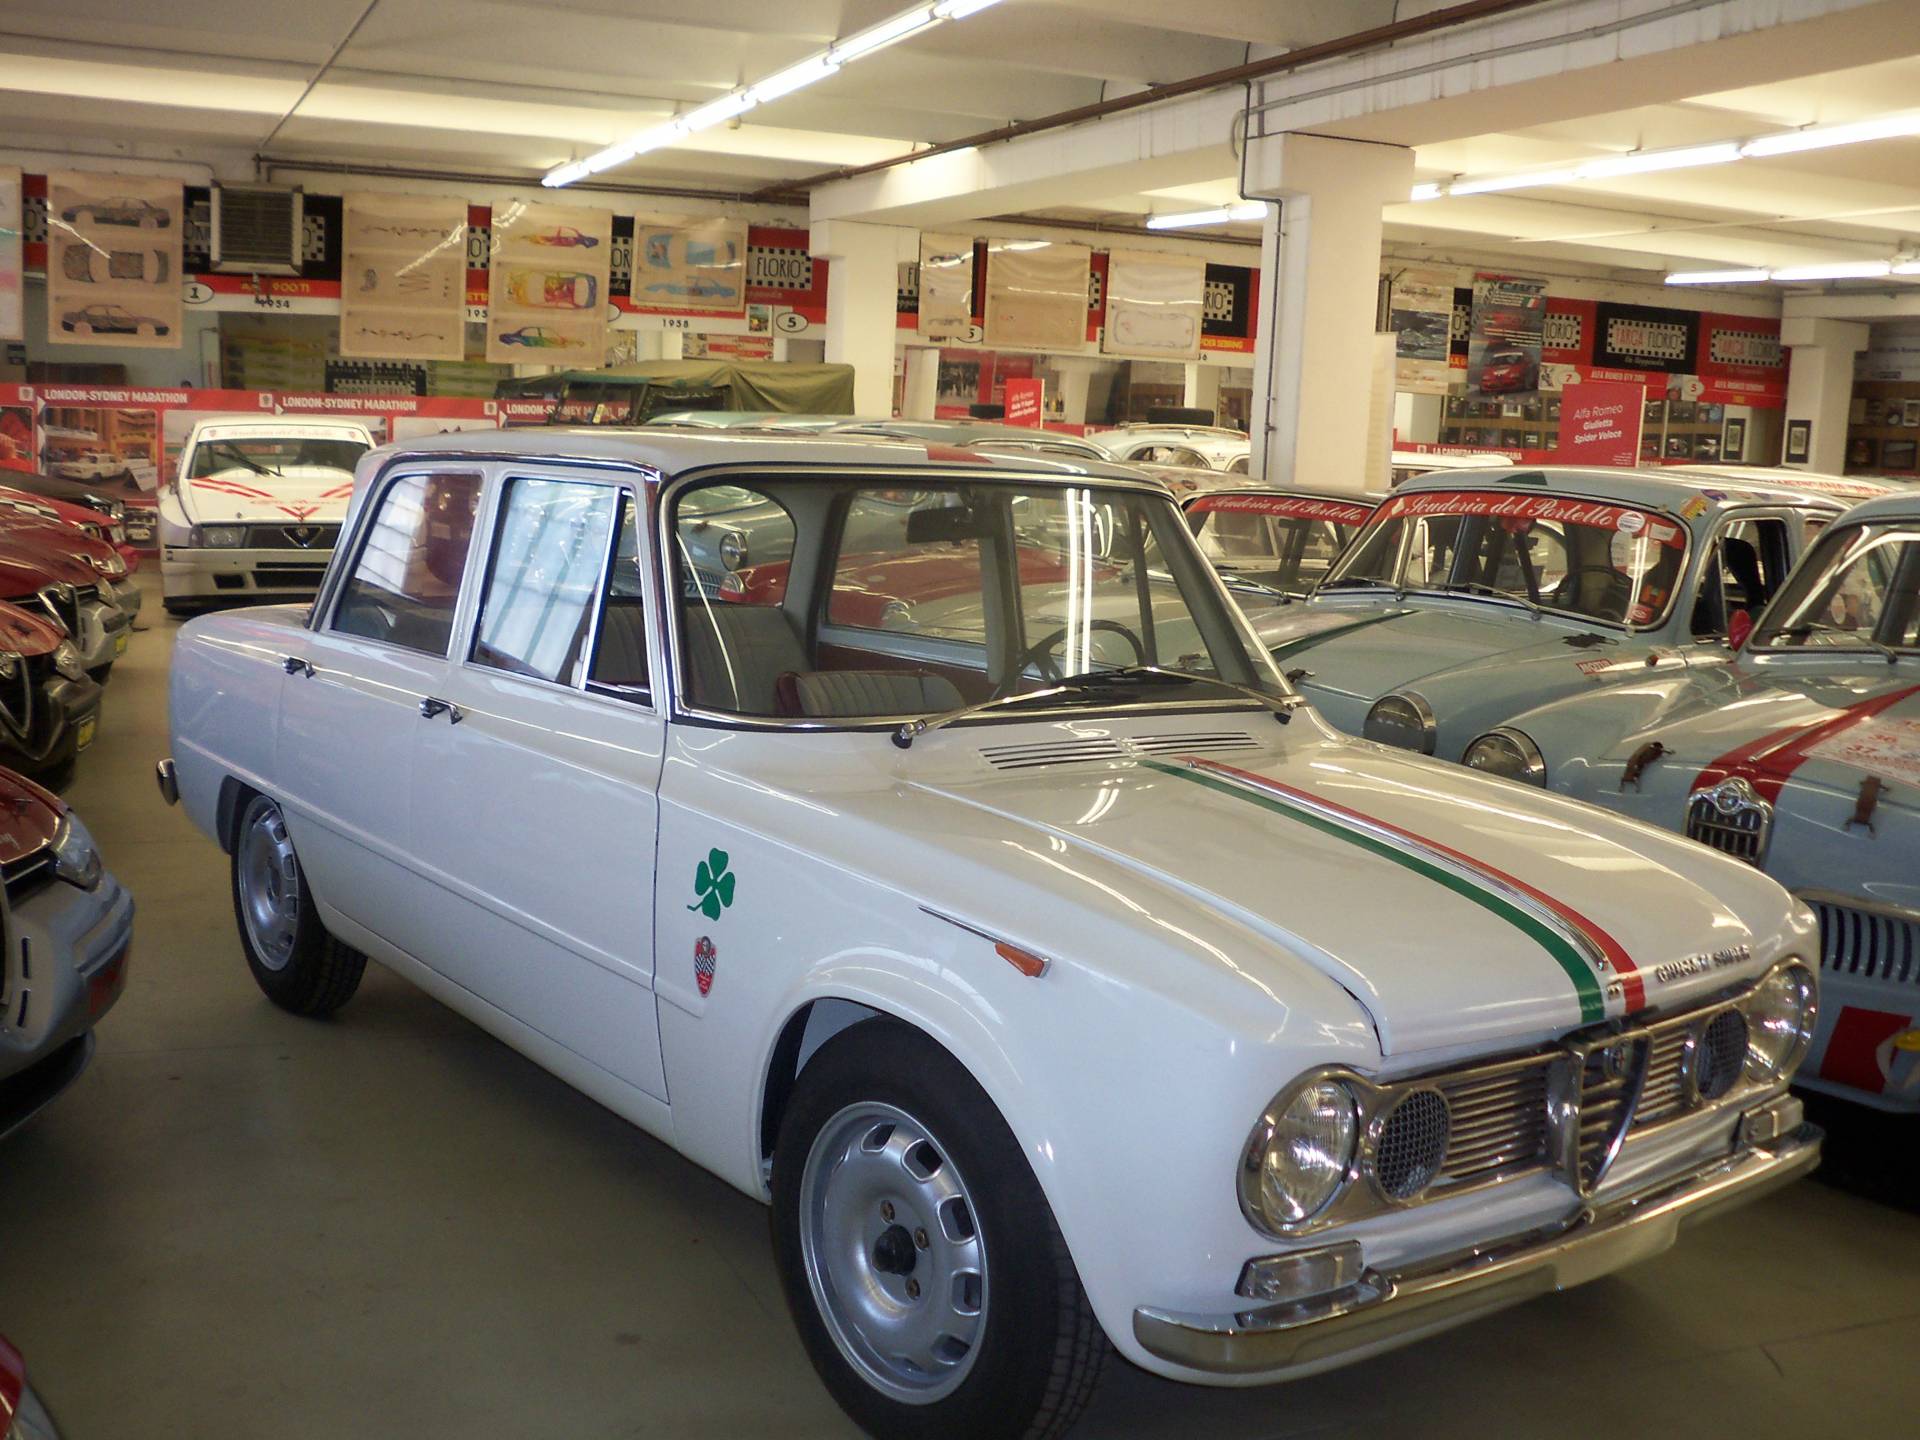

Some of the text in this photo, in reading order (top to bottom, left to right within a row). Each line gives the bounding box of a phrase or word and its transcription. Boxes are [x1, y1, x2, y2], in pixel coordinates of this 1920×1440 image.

[757, 256, 801, 278] FLORIO
[662, 318, 689, 328] 1958
[787, 317, 797, 328] 5
[1615, 327, 1679, 350] TARGA FLORIO
[1565, 374, 1573, 383] 7
[45, 388, 188, 404] LONDON-SYDNEY MARATHON
[282, 396, 417, 411] LONDON-SYDNEY MARATHON
[1573, 404, 1624, 419] Alfa Romeo
[1583, 418, 1614, 431] Giulietta
[1574, 430, 1623, 444] Spider Veloce
[1208, 496, 1363, 521] Scuderia del Portello
[1404, 495, 1485, 514] Scuderia
[1490, 495, 1522, 514] del
[1526, 498, 1614, 527] Portello
